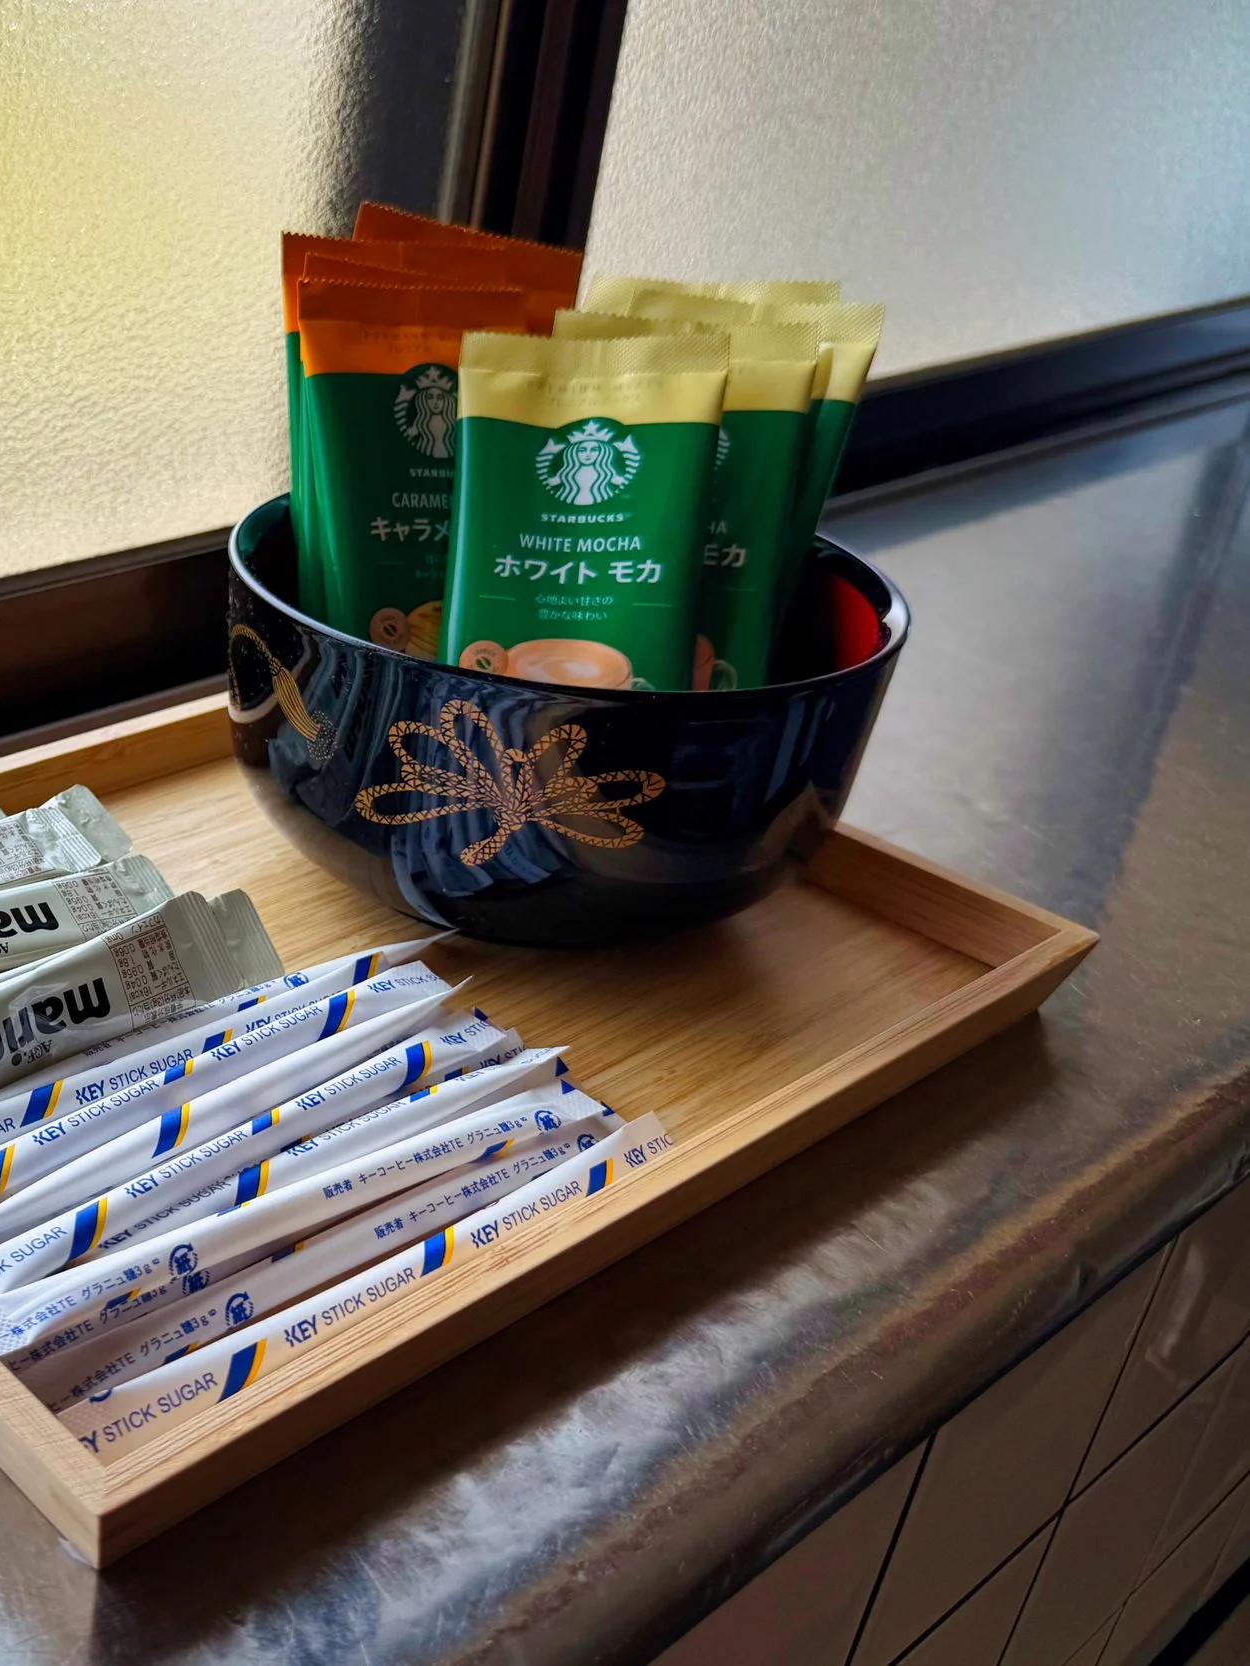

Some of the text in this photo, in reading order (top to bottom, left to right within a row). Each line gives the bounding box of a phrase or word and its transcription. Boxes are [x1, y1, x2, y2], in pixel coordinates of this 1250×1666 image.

[541, 513, 625, 524] STARBUCKS
[519, 533, 642, 553] WHITE MOCHA
[494, 555, 663, 585] ホワイト モカ
[535, 593, 613, 607] 心地よい甘さの
[538, 609, 608, 621] 豊かな味わい
[130, 914, 160, 934] カフェイン
[112, 941, 135, 958] 0.06g
[117, 954, 135, 969] 1.8g
[120, 963, 144, 980] 0.95g
[124, 973, 148, 990] 0.04g
[127, 971, 185, 1002] エネルギー 16kcal
[368, 979, 396, 994] KEY
[210, 1002, 323, 1062] KEY STICK SUGAR
[439, 1030, 467, 1046] KEY
[74, 1047, 194, 1105] KEY STICK SUGAR
[296, 1053, 402, 1112] KEY STICK SUGAR
[31, 1077, 160, 1147] KEY STICK SUGAR
[124, 1127, 248, 1200] KEY STICK SUGAR
[286, 1137, 319, 1159] KEY
[322, 1116, 522, 1199] 販売者 キーコーヒー株式会社TE グラニュ糖3g
[623, 1144, 647, 1169] KEY
[373, 1143, 566, 1240] 販売者 キーコーヒー株式会社TE グラニュ糖3g
[97, 1227, 134, 1251] KEY
[135, 1204, 178, 1230] STICK
[470, 1179, 581, 1248] KEY STICK SUGAR
[10, 1223, 67, 1264] SUGAR
[80, 1260, 152, 1300] グラニュ糖3g
[282, 1266, 416, 1348] KEY STICK SUGAR
[139, 1313, 209, 1357] グラニュ糖3g
[101, 1403, 157, 1444] STICK
[156, 1371, 218, 1414] SUGAR
